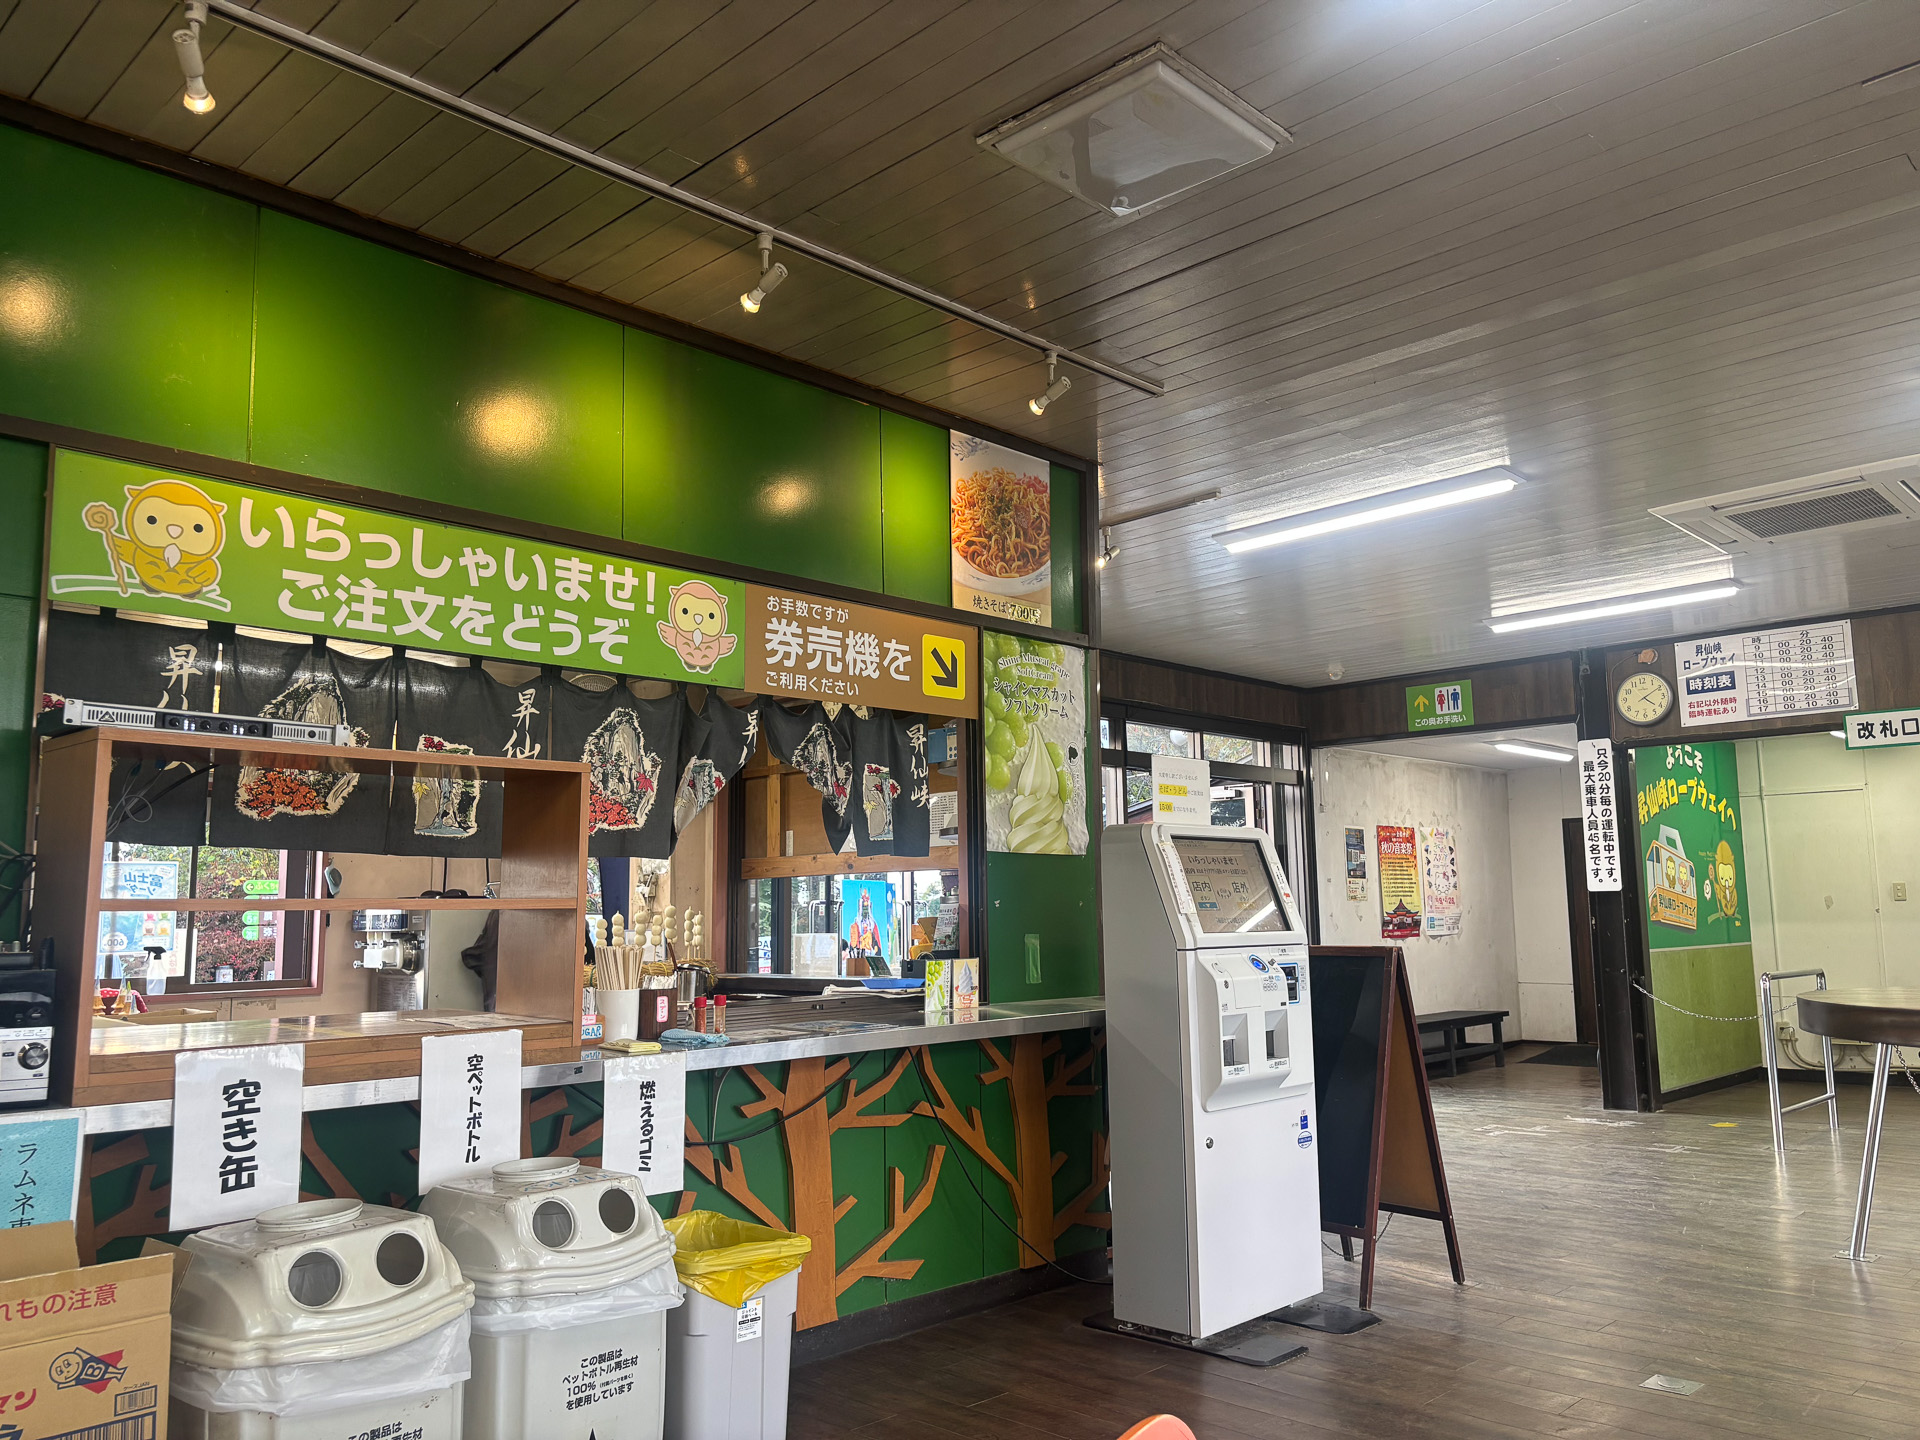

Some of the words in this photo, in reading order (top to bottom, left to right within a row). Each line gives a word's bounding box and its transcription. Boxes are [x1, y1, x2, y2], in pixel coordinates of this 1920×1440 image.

[239, 497, 656, 614] いらっしゃいませ!
[278, 568, 630, 665] ご注文をどうぞ
[767, 595, 849, 624] お手数ですが
[973, 595, 1007, 613] 焼きそば
[1799, 630, 1810, 638] 分
[765, 617, 912, 682] 券売機を
[1683, 653, 1736, 670] ロープウェイ
[1695, 642, 1723, 657] 昇仙峡
[998, 655, 1021, 670] Shine
[1050, 662, 1071, 680] grape
[765, 670, 859, 696] ご利用ください
[993, 677, 1077, 705] シャインマスカット
[1689, 675, 1732, 691] 時刻表
[1003, 698, 1070, 720] ソフトクリーム
[1415, 714, 1467, 727] この奥お手洗い
[1856, 717, 1919, 739] 改札口
[906, 723, 930, 809] 昇仙峡
[1665, 744, 1703, 775] ようこそ
[1597, 748, 1618, 883] 只今20分毎の運転中です。
[1637, 776, 1737, 831] 昇仙峡ロープウェイへ
[1583, 760, 1603, 883] 最大乗車人員45名です。
[1381, 841, 1413, 855] 秋の音楽祭
[1192, 881, 1212, 892] 店内
[1231, 881, 1250, 894] 店外
[465, 1054, 484, 1163] 空ペットボトル
[219, 1078, 262, 1194] 空き缶
[638, 1080, 656, 1172] 燃えるゴミ
[562, 1354, 638, 1384] ペットボトル再生材
[580, 1348, 623, 1368] この製品は
[566, 1381, 634, 1411] を使用しています
[567, 1381, 597, 1397] 100%
